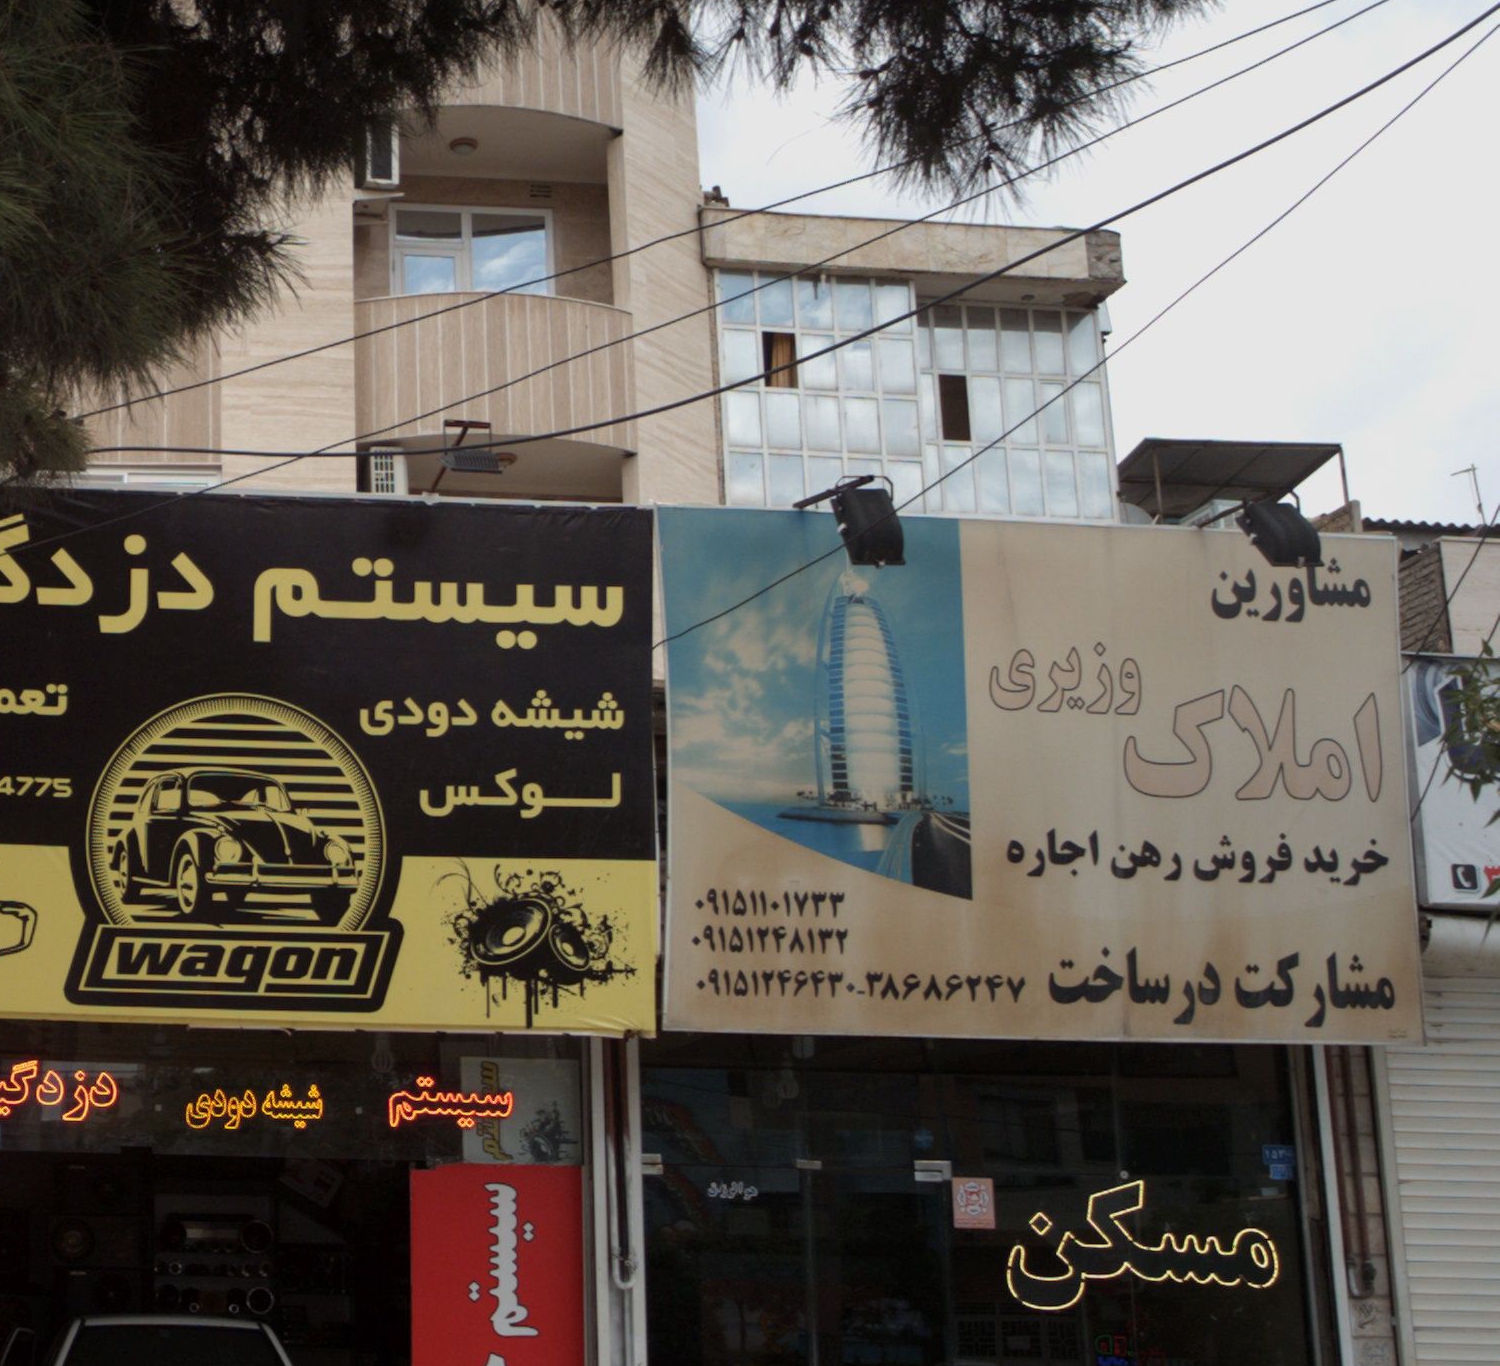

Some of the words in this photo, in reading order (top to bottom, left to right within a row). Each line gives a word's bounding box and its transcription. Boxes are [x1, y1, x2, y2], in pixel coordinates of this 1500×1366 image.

[252, 557, 625, 651] سیستم
[1211, 558, 1372, 622] مشاورین
[989, 642, 1142, 715] وزیری
[359, 697, 478, 737] دودی
[491, 689, 625, 740] شیشه
[1123, 684, 1383, 803] املاک
[419, 768, 622, 819] لوکس
[1006, 827, 1099, 877] اجاره
[1110, 839, 1182, 881] رهن
[1192, 832, 1293, 884] فروش
[1303, 838, 1389, 886] خرید
[694, 888, 846, 918] ۰۹۱۵۱۱۰۱۷۳۳
[115, 941, 359, 987] wagon
[691, 925, 849, 955] ۰۹۱۵۱۲۴۸۱۳۲
[1048, 946, 1171, 1005] ساخت
[1173, 961, 1221, 1025] در
[1234, 950, 1396, 1028] مشارکت
[185, 1088, 257, 1130] دودی
[261, 1083, 324, 1129] شیشه
[387, 1075, 514, 1129] سیستم
[467, 1182, 540, 1337] سیستم
[1006, 1179, 1280, 1311] مسکن
